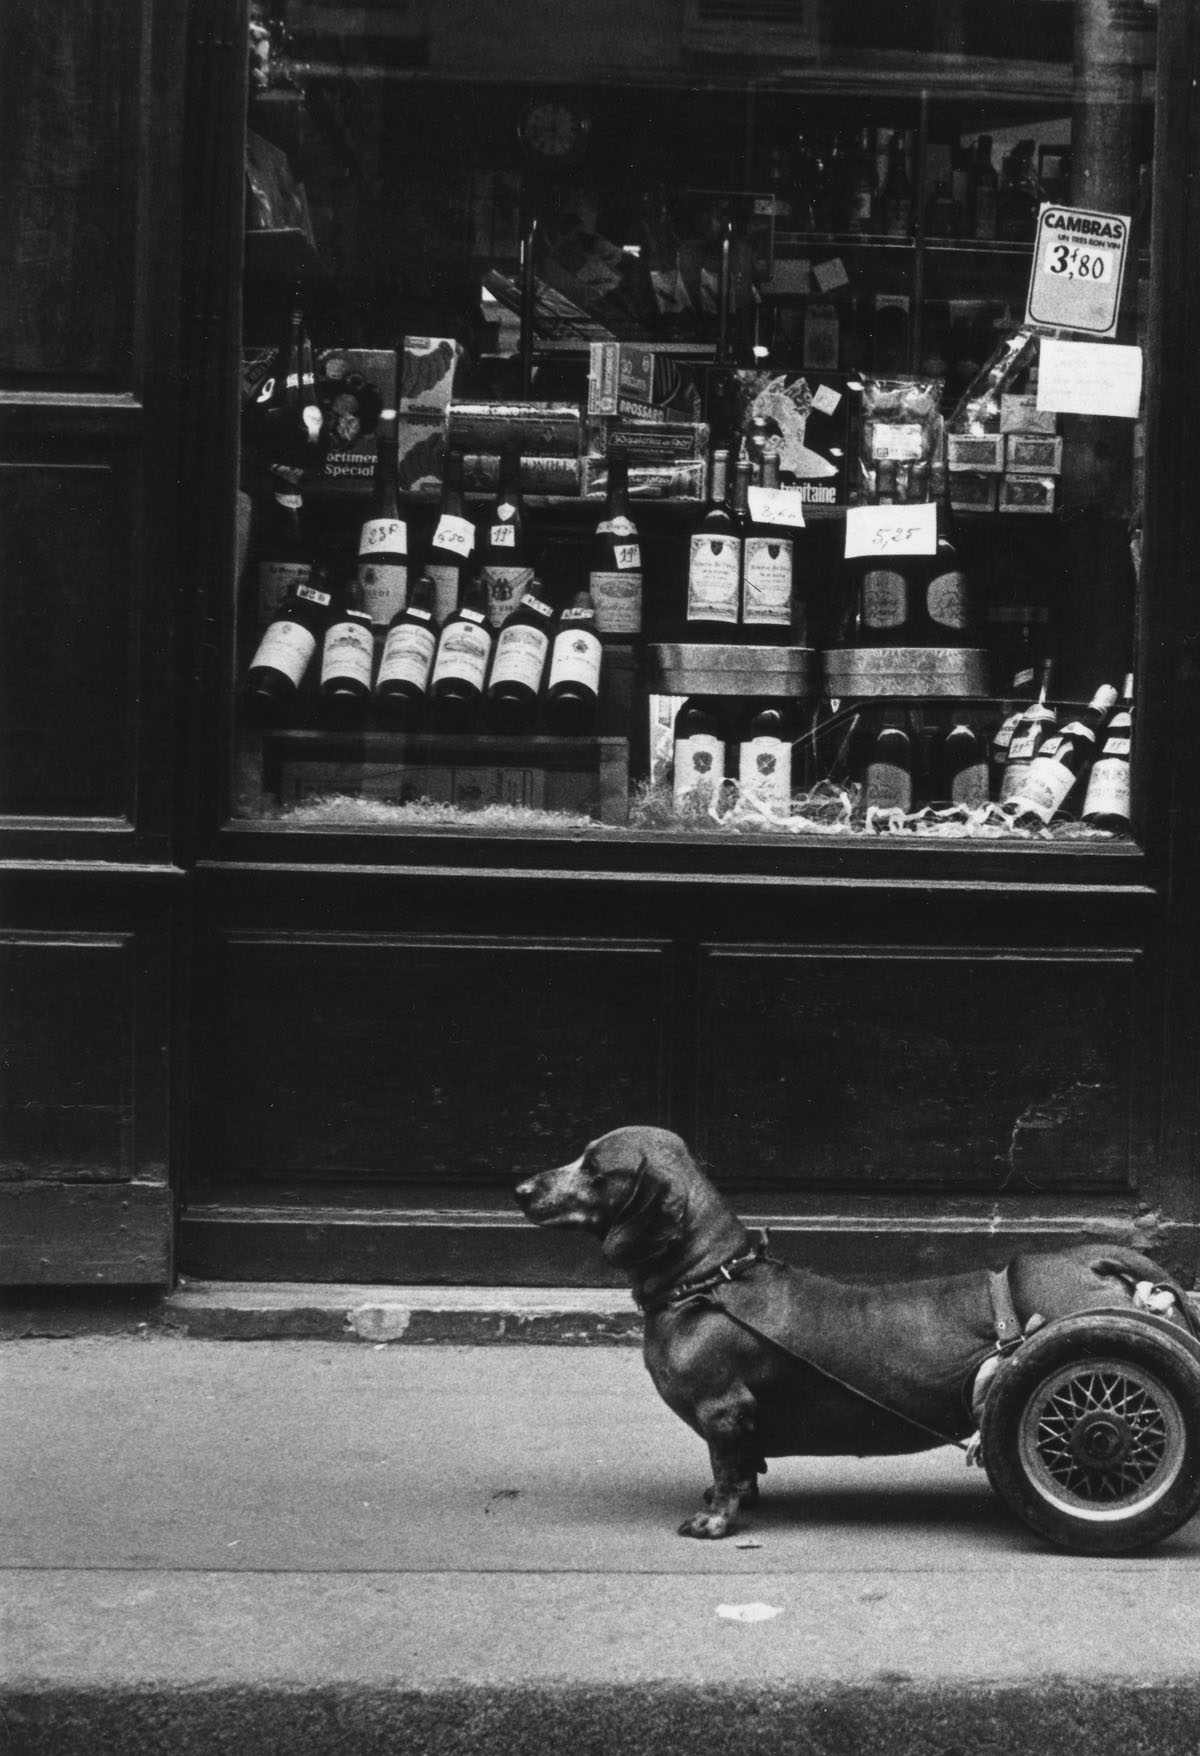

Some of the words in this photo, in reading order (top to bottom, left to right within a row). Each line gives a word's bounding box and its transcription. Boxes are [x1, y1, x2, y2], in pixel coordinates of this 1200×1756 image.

[1044, 213, 1122, 239] CAMBRAS
[1057, 234, 1070, 242] UN
[1089, 238, 1105, 248] BON
[1107, 240, 1121, 250] VIN
[619, 400, 664, 421] BROSSARD
